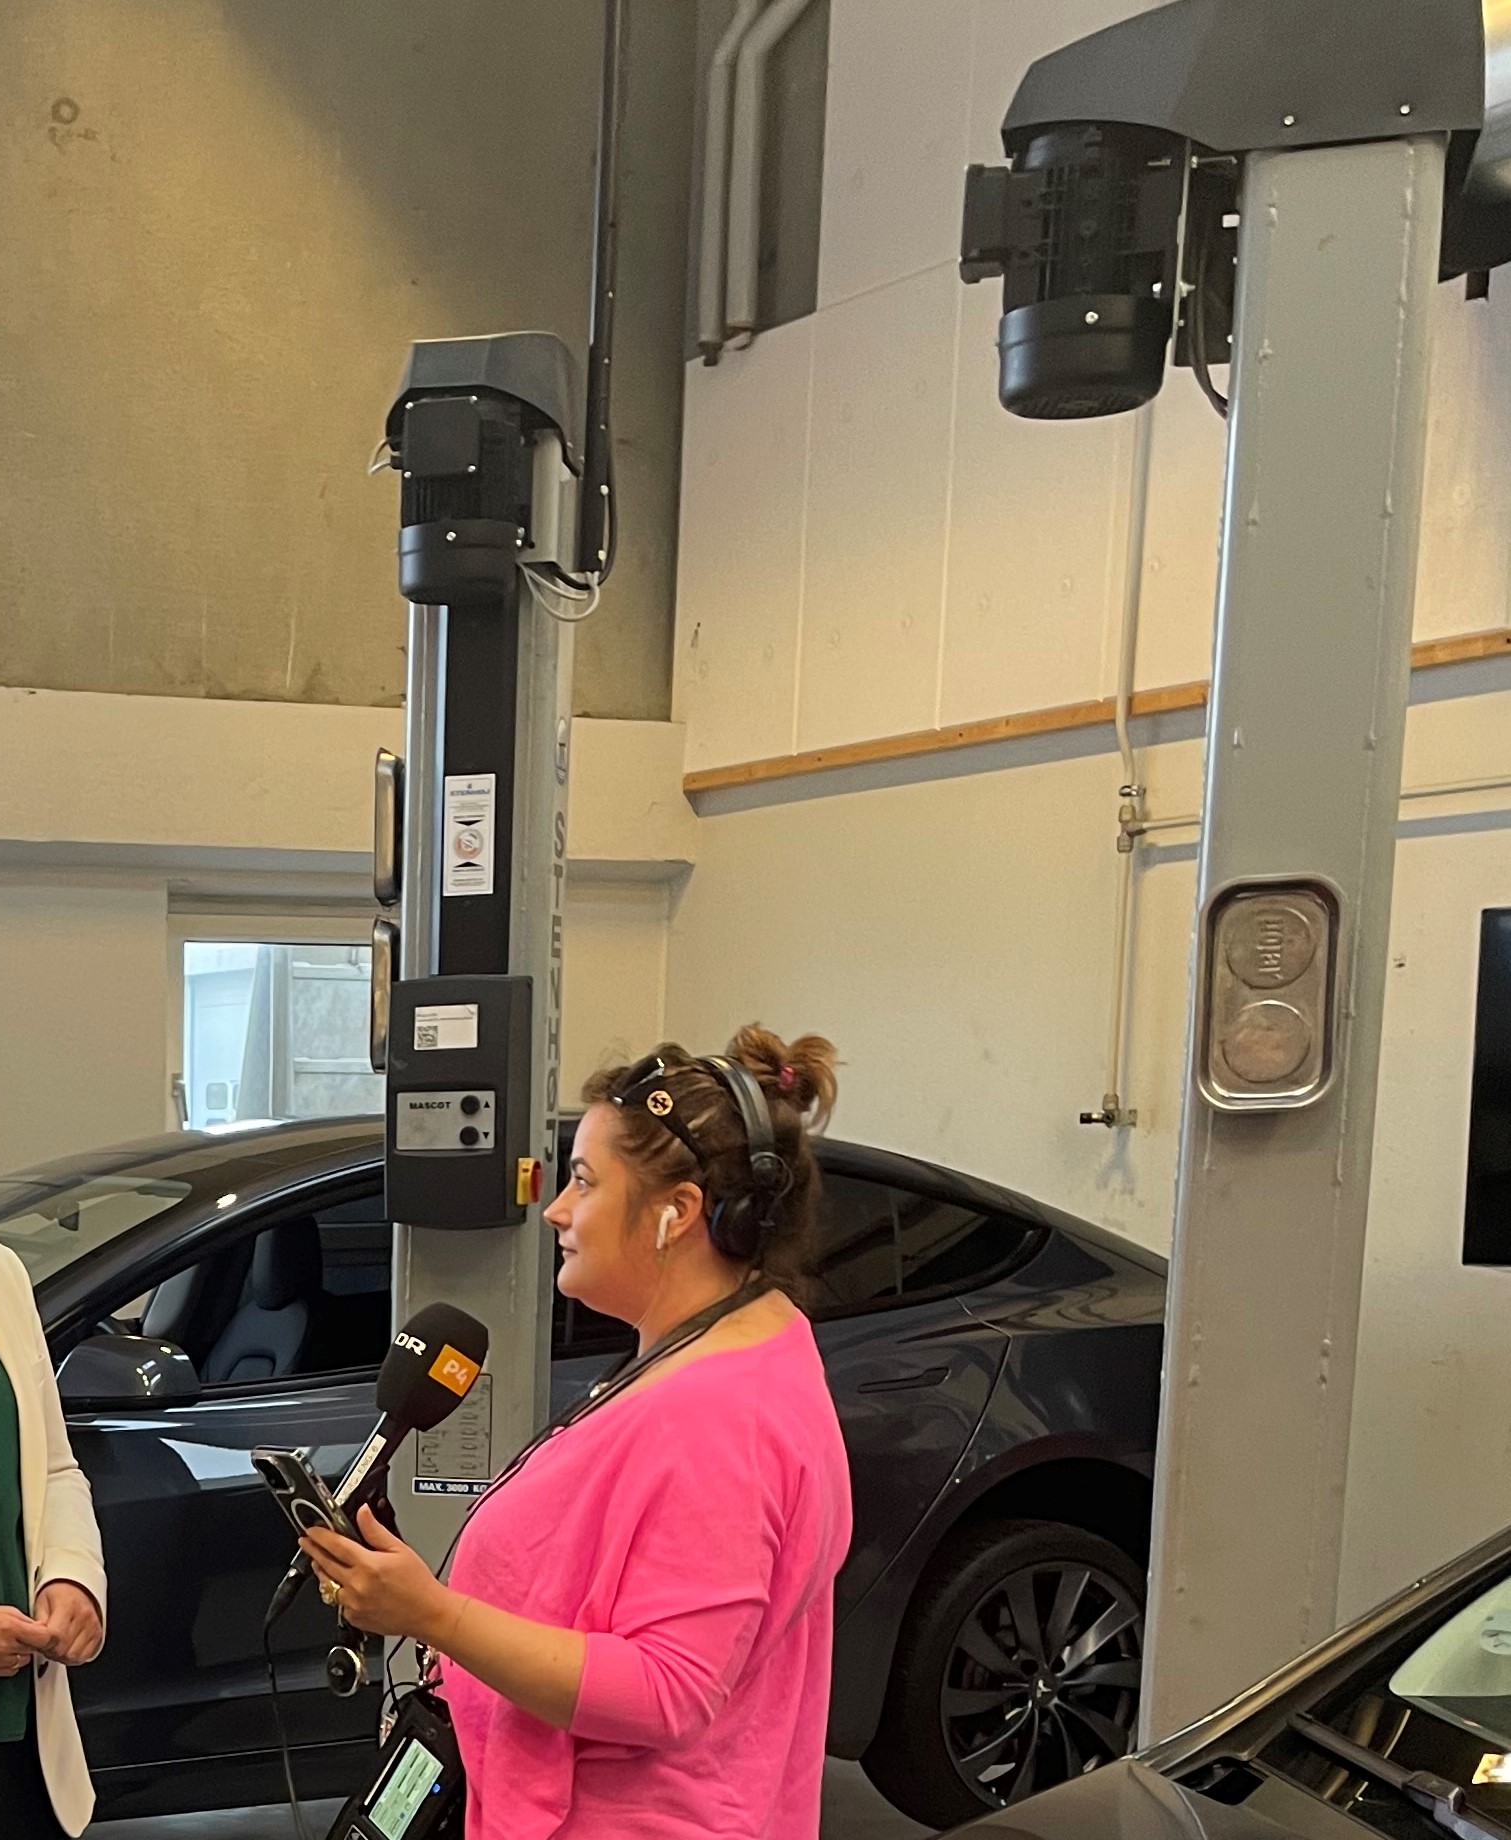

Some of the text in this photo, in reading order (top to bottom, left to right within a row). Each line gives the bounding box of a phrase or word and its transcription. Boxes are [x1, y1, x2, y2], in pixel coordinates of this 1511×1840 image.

[409, 1101, 451, 1110] MASCOT
[394, 1332, 427, 1356] DR
[442, 1359, 468, 1386] P4
